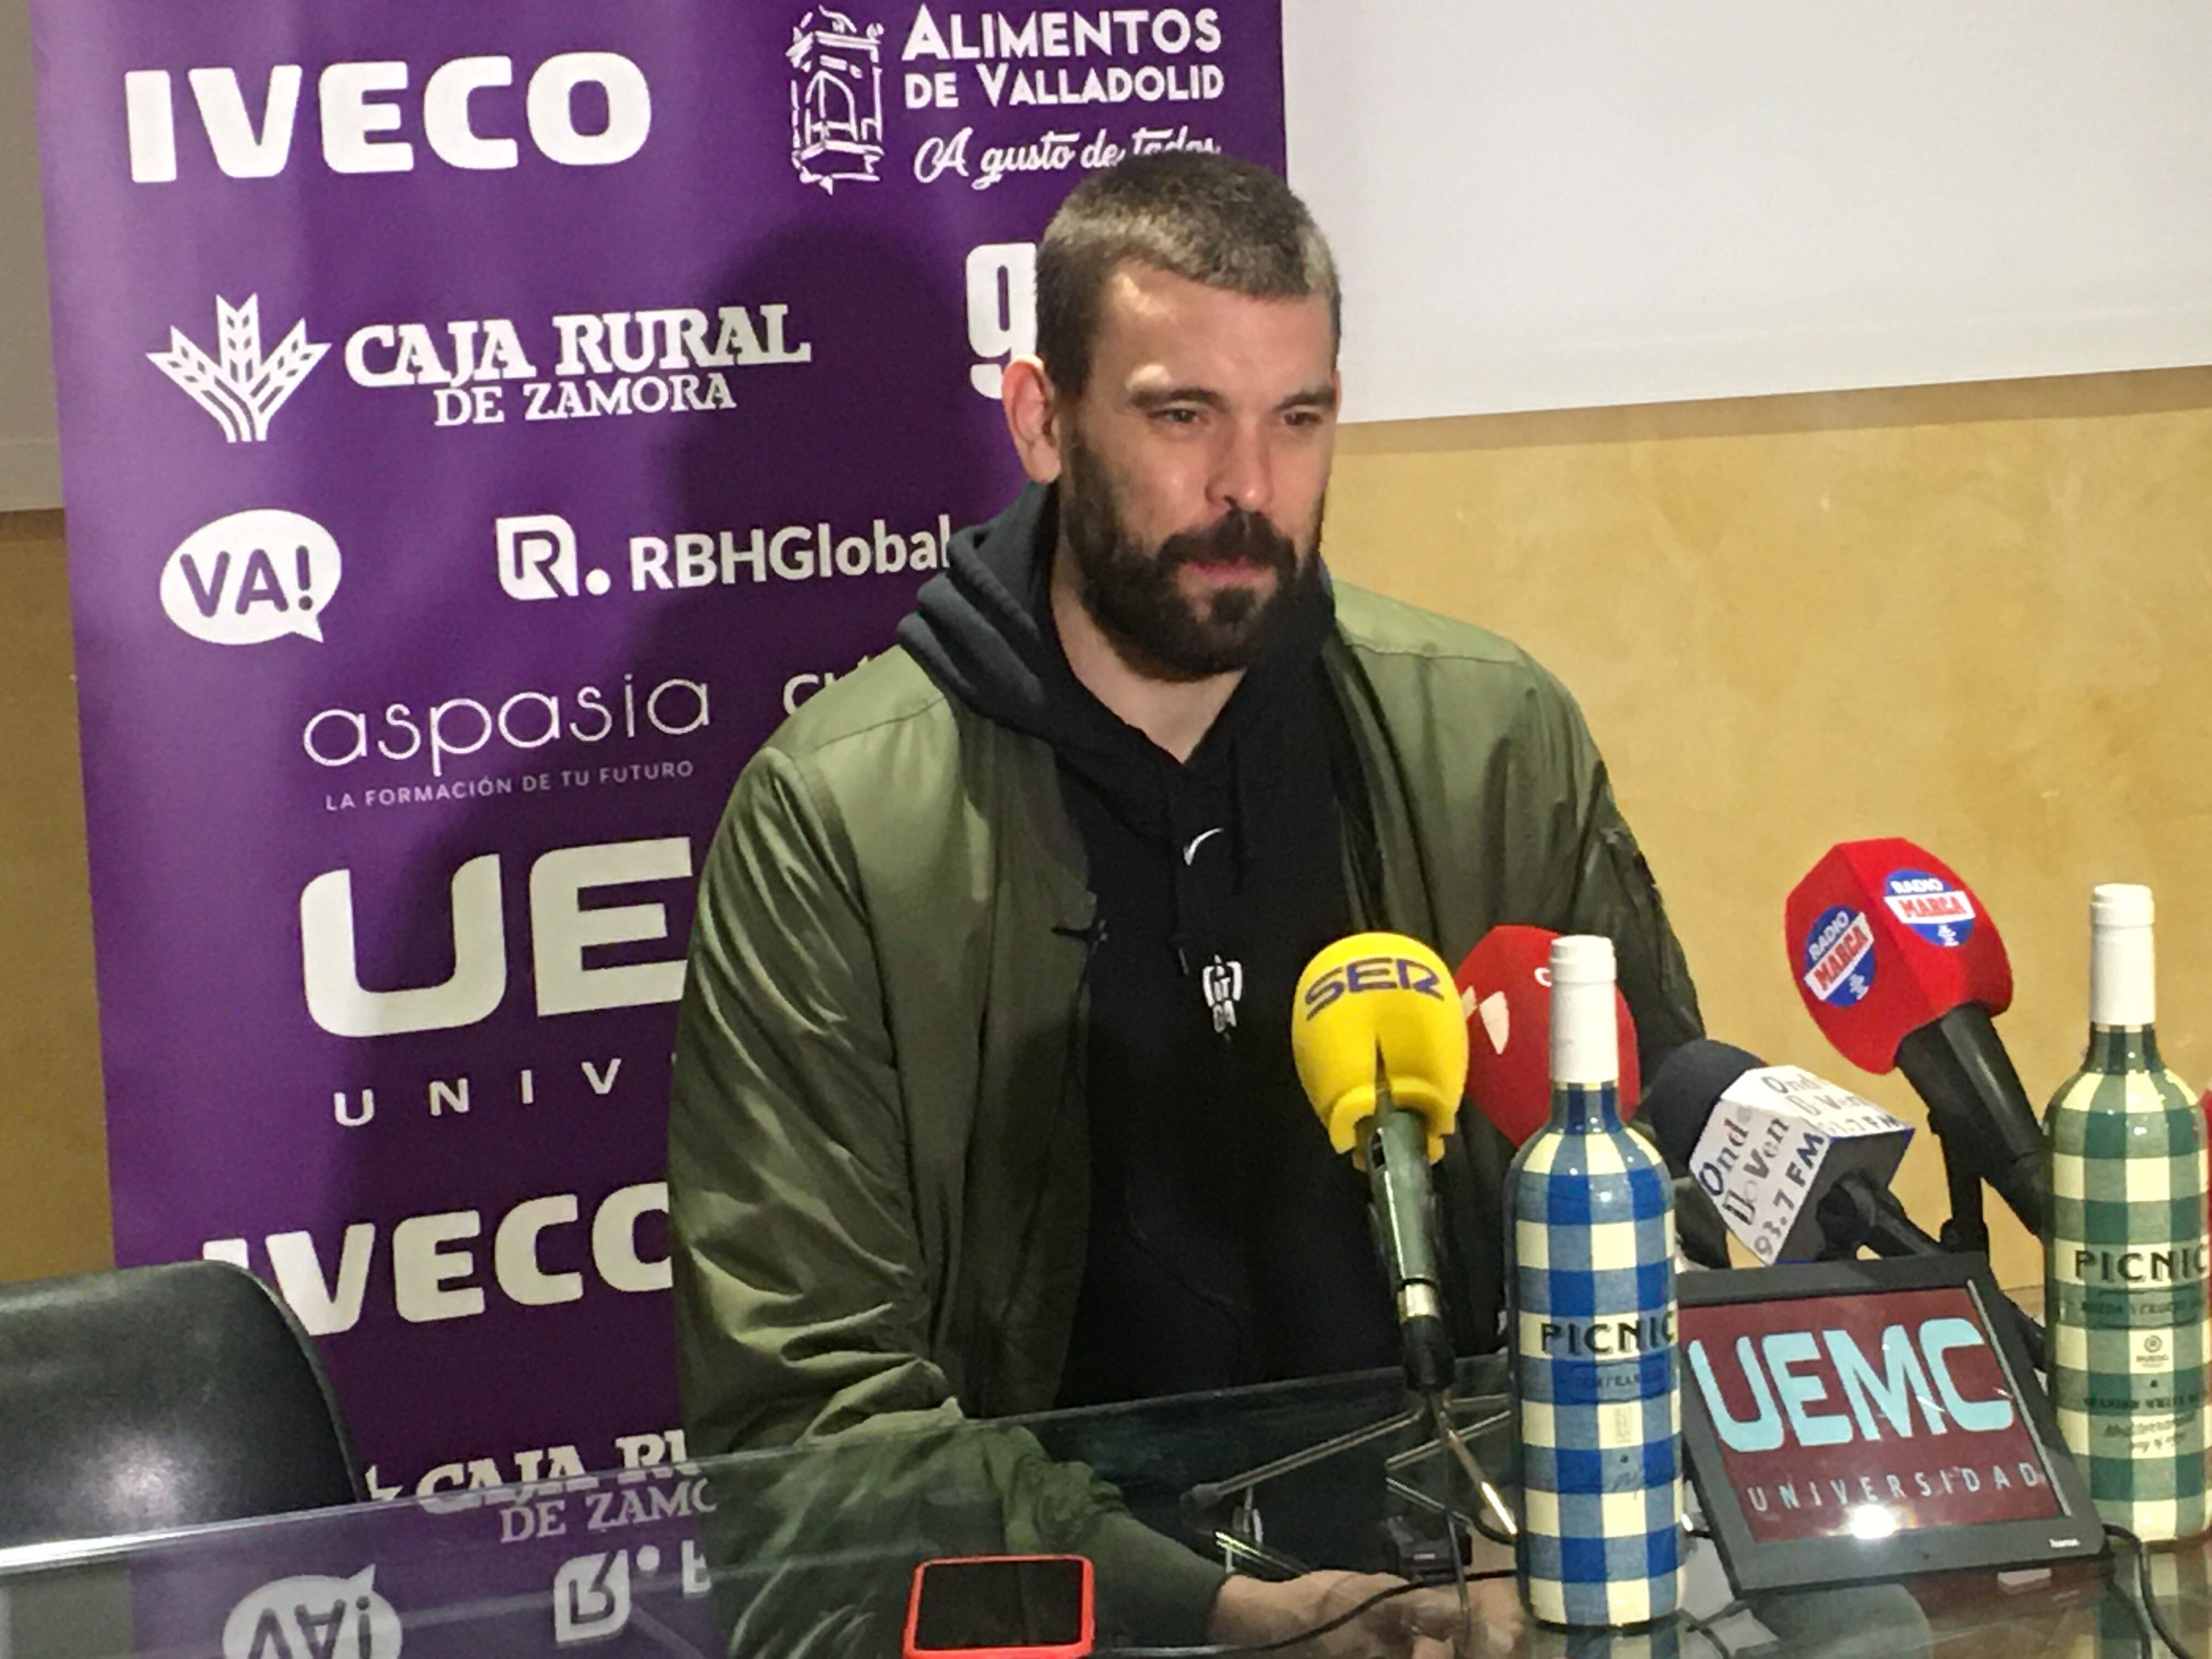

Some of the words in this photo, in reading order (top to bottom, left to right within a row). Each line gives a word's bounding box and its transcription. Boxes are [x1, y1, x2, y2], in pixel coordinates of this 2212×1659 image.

[125, 52, 652, 183] IVECO
[904, 72, 959, 109] DE
[913, 126, 974, 183] A
[971, 131, 1081, 190] gusto
[1080, 128, 1126, 168] de
[345, 319, 537, 387] CAJA
[552, 304, 812, 376] RURAL
[433, 386, 504, 426] DE
[523, 372, 737, 421] ZAMORA
[179, 544, 313, 618] VA!
[629, 514, 950, 592] RBHGlobal
[303, 674, 709, 777] aspasia
[326, 793, 356, 811] LA
[364, 775, 512, 807] FORMACIÓN
[522, 774, 551, 792] DE
[561, 770, 590, 786] TU
[599, 760, 695, 783] FUTURO
[1808, 911, 1849, 961] RADIO
[1898, 895, 1968, 918] MARCA
[1305, 957, 1444, 1022] SER
[1814, 926, 1869, 992] MARCA
[334, 1053, 679, 1126] UNIV
[1785, 1132, 1825, 1188] FM
[1687, 1318, 2013, 1453] UEMC
[416, 1445, 600, 1514] CAJA
[1747, 1462, 2037, 1511] UNIVERSIDAD
[500, 1499, 568, 1543] DE
